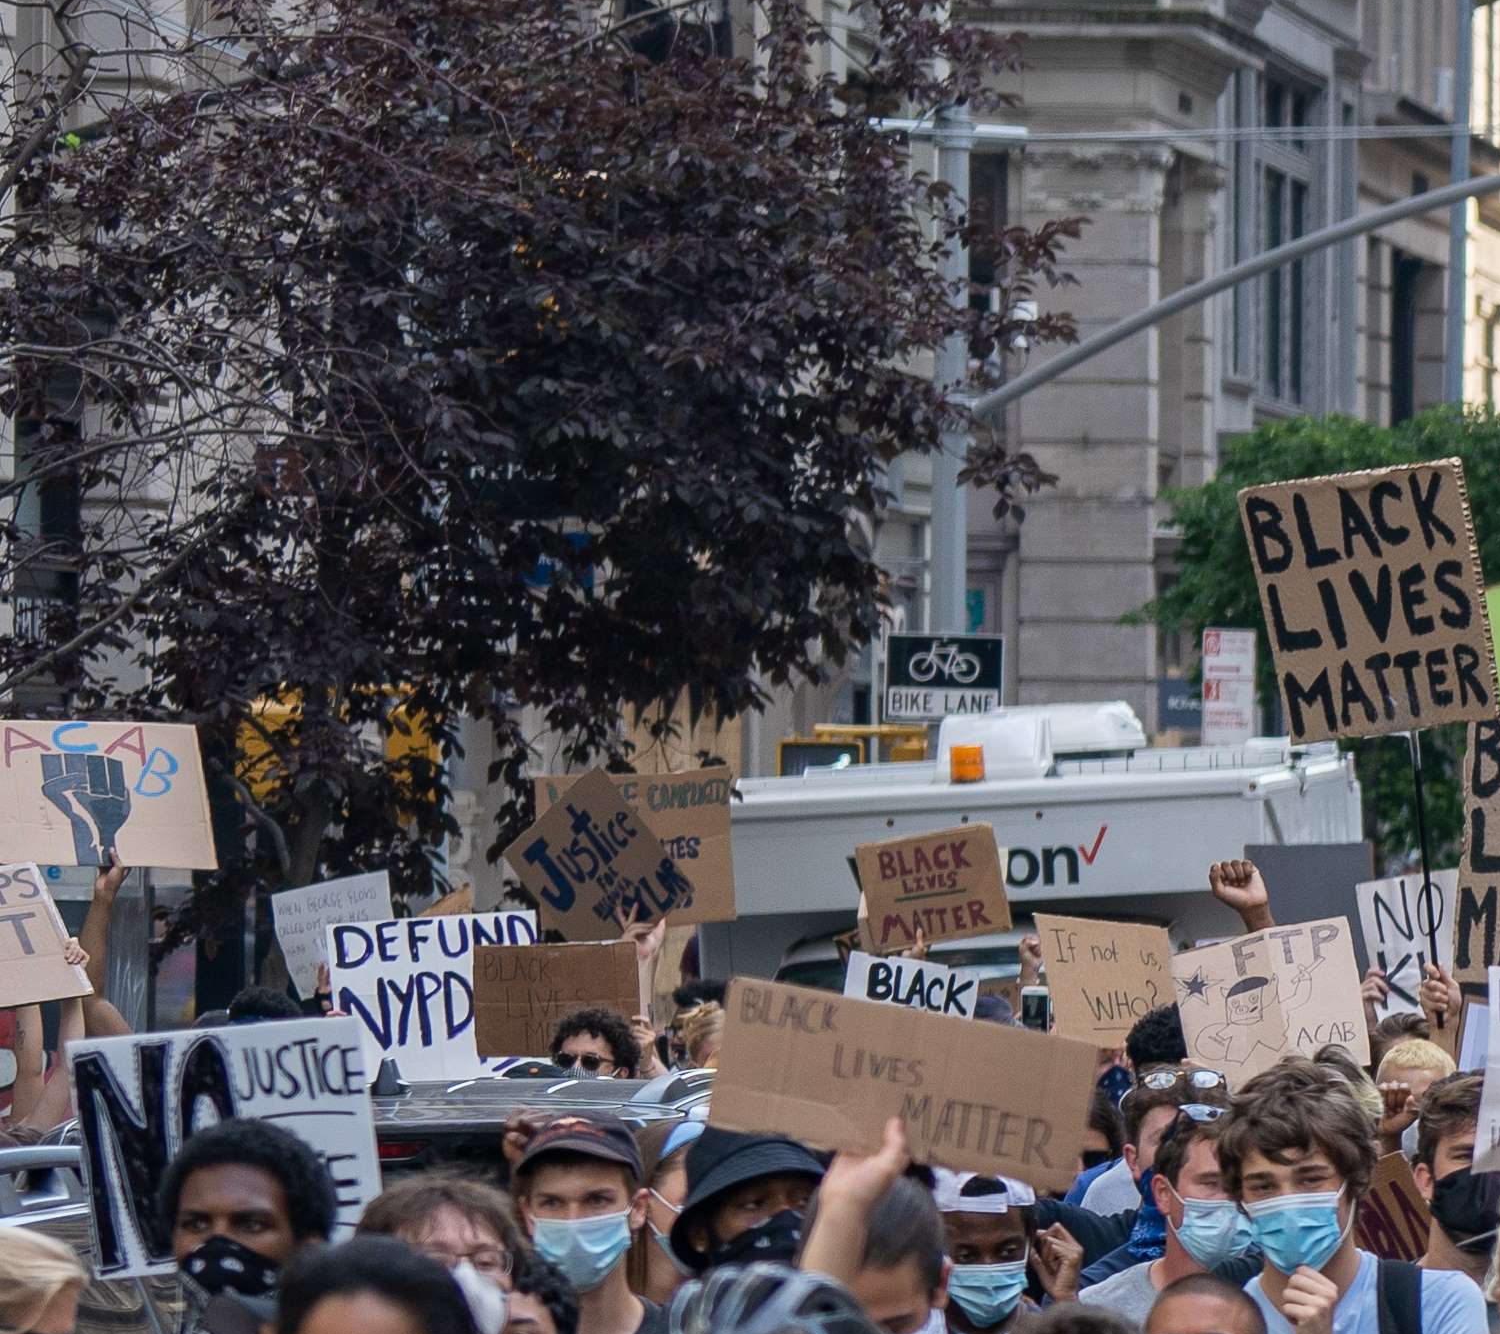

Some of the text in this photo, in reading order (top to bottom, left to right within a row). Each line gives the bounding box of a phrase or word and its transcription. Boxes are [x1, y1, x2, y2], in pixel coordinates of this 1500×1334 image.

[1245, 471, 1456, 574] BLACK
[1267, 560, 1472, 652] LIVES
[891, 689, 999, 714] BIKE LANE
[1283, 643, 1488, 738] MATTER
[523, 801, 638, 912] Justice
[878, 839, 971, 881] BLACK
[902, 872, 957, 894] LIVES
[880, 900, 992, 945] MATTER
[1373, 882, 1444, 943] NO
[333, 915, 537, 969] DEFUND
[484, 953, 550, 983] BLACK
[1050, 928, 1163, 971] If not us,
[1232, 924, 1339, 977] FTP
[339, 971, 475, 1051] NYPD
[741, 987, 840, 1034] BLACK
[866, 962, 973, 1017] BLACK
[1297, 1021, 1357, 1045] ACAB
[237, 1038, 364, 1101] JUSTICE
[832, 1044, 926, 1088] LIVES
[900, 1093, 1052, 1168] MATTER
